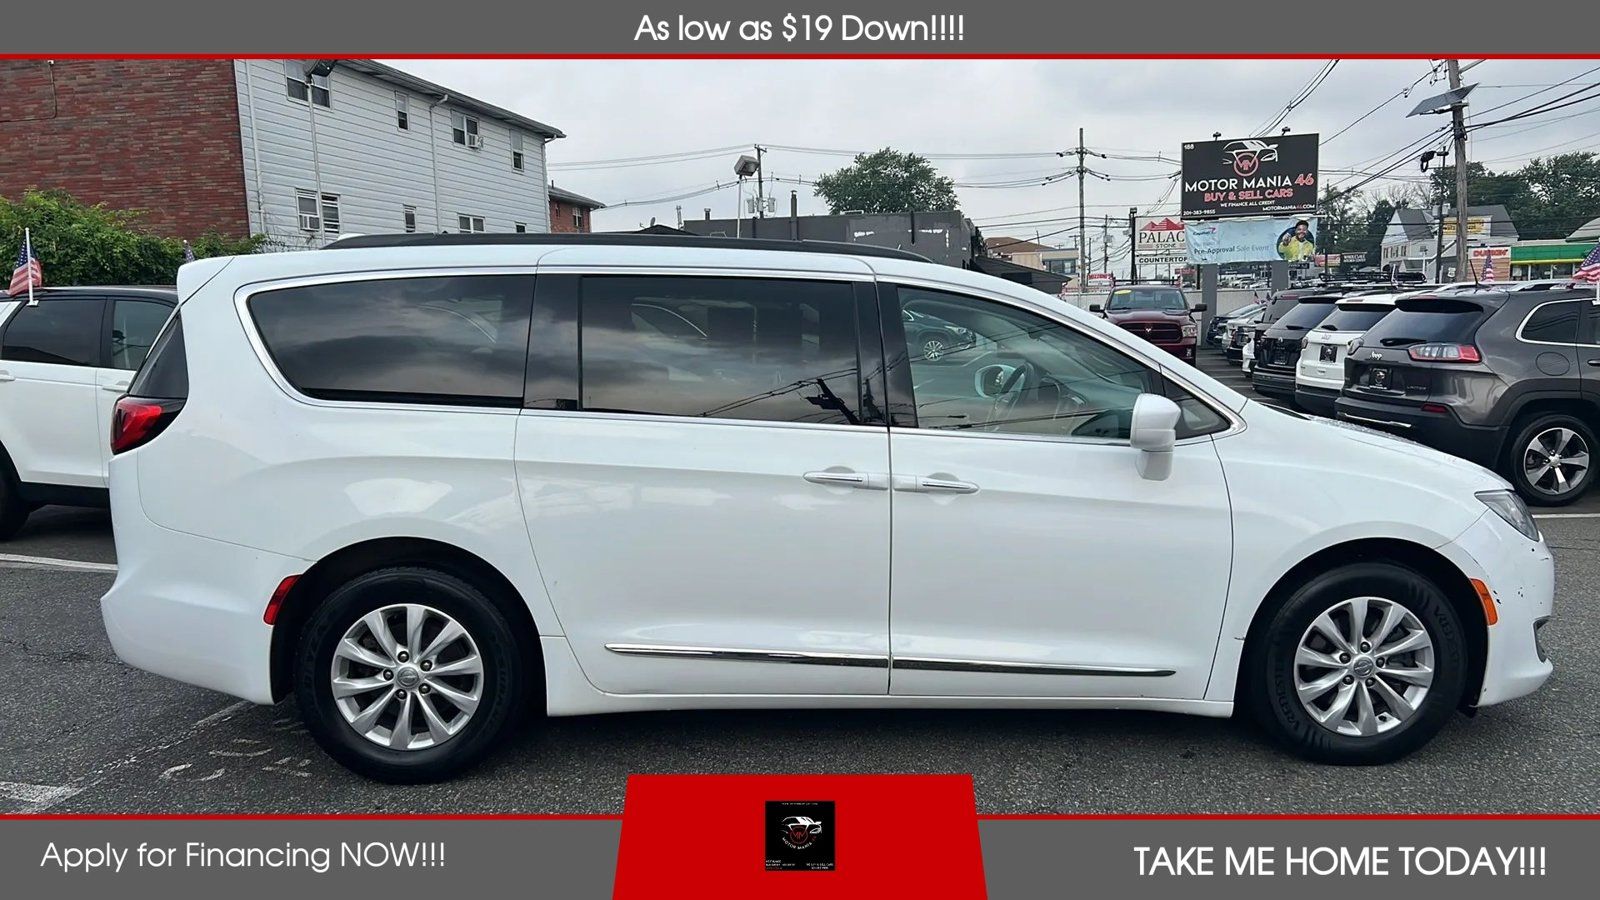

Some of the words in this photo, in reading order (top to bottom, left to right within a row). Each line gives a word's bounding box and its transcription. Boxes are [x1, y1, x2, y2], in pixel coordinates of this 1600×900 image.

[1185, 178, 1238, 193] MOTOR
[1243, 175, 1293, 189] MANIA
[1294, 173, 1315, 186] 46
[1204, 191, 1226, 202] BUY
[1228, 190, 1237, 201] &
[1238, 190, 1263, 201] SELL
[1265, 188, 1294, 198] CARS
[1139, 230, 1185, 243] PALAC
